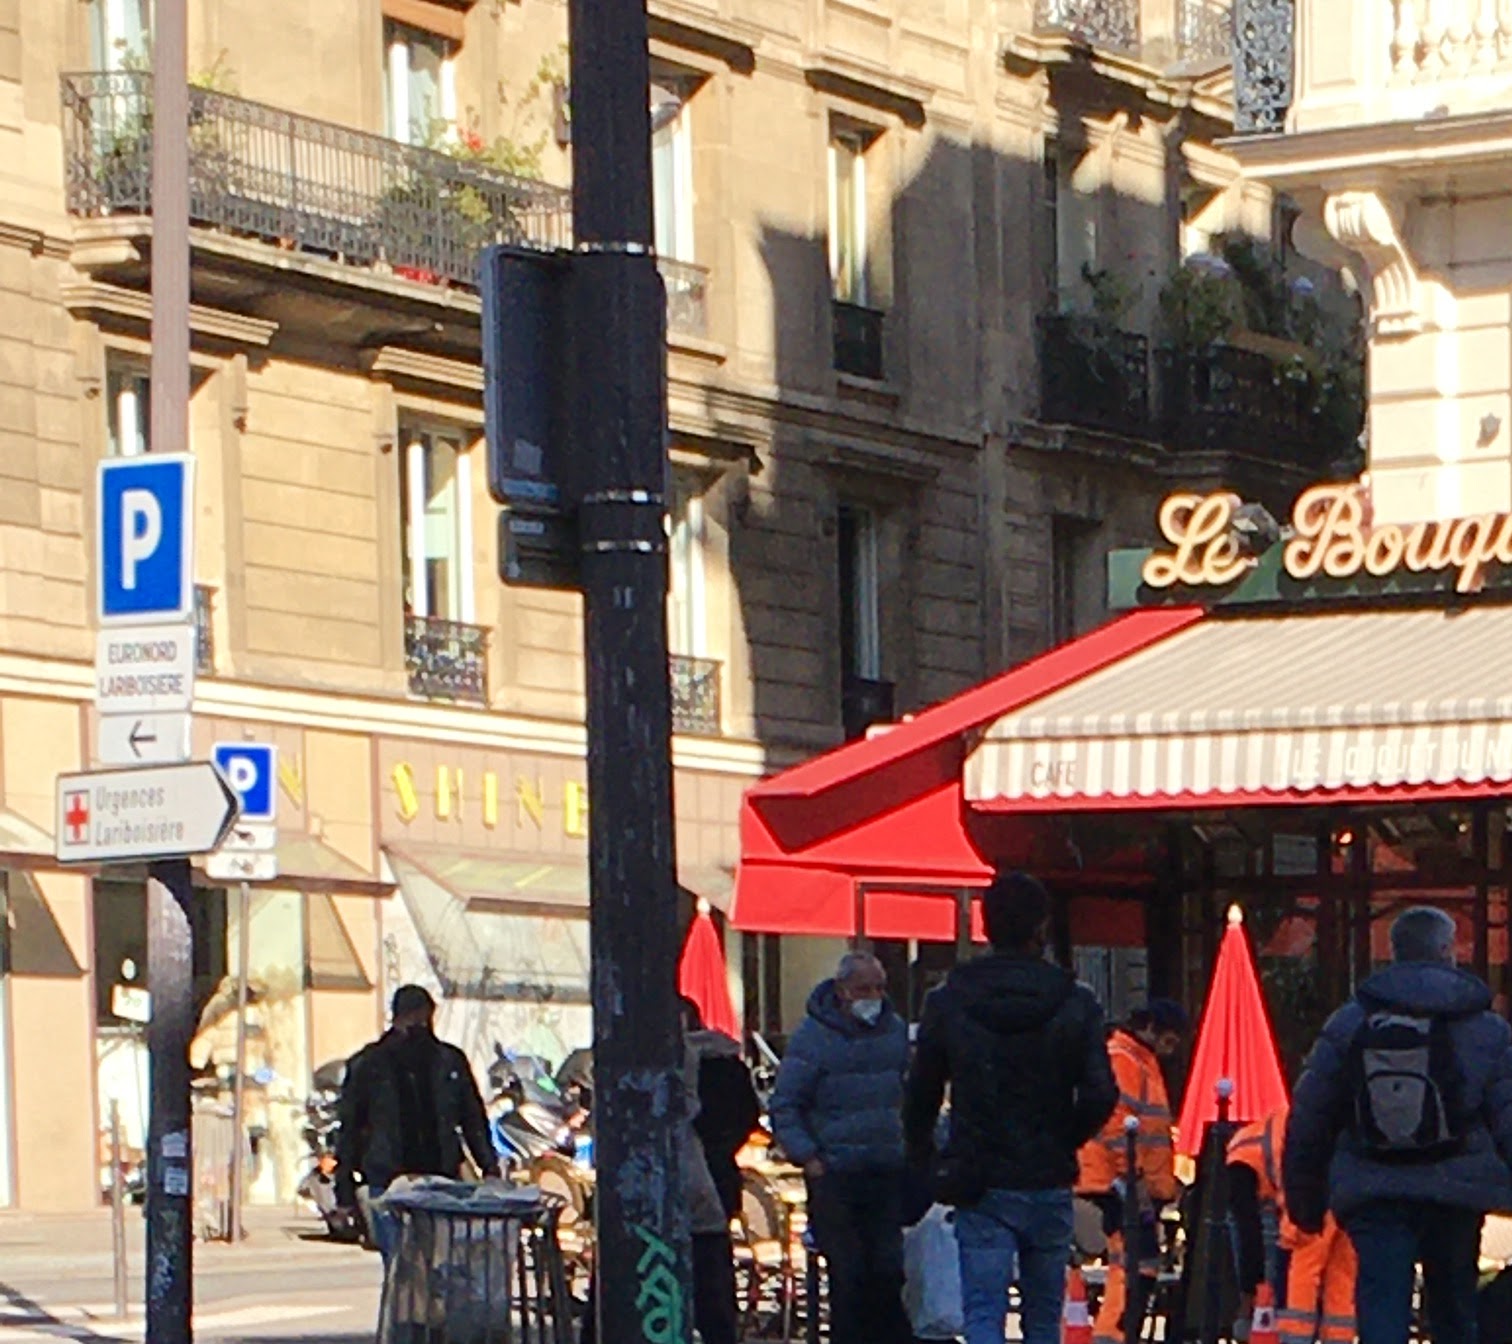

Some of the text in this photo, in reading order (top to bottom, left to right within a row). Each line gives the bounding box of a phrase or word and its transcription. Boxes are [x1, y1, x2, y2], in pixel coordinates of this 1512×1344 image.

[121, 487, 163, 590] P
[1142, 492, 1257, 587] Le
[107, 640, 178, 665] EURONORD
[94, 786, 166, 816] Urgences
